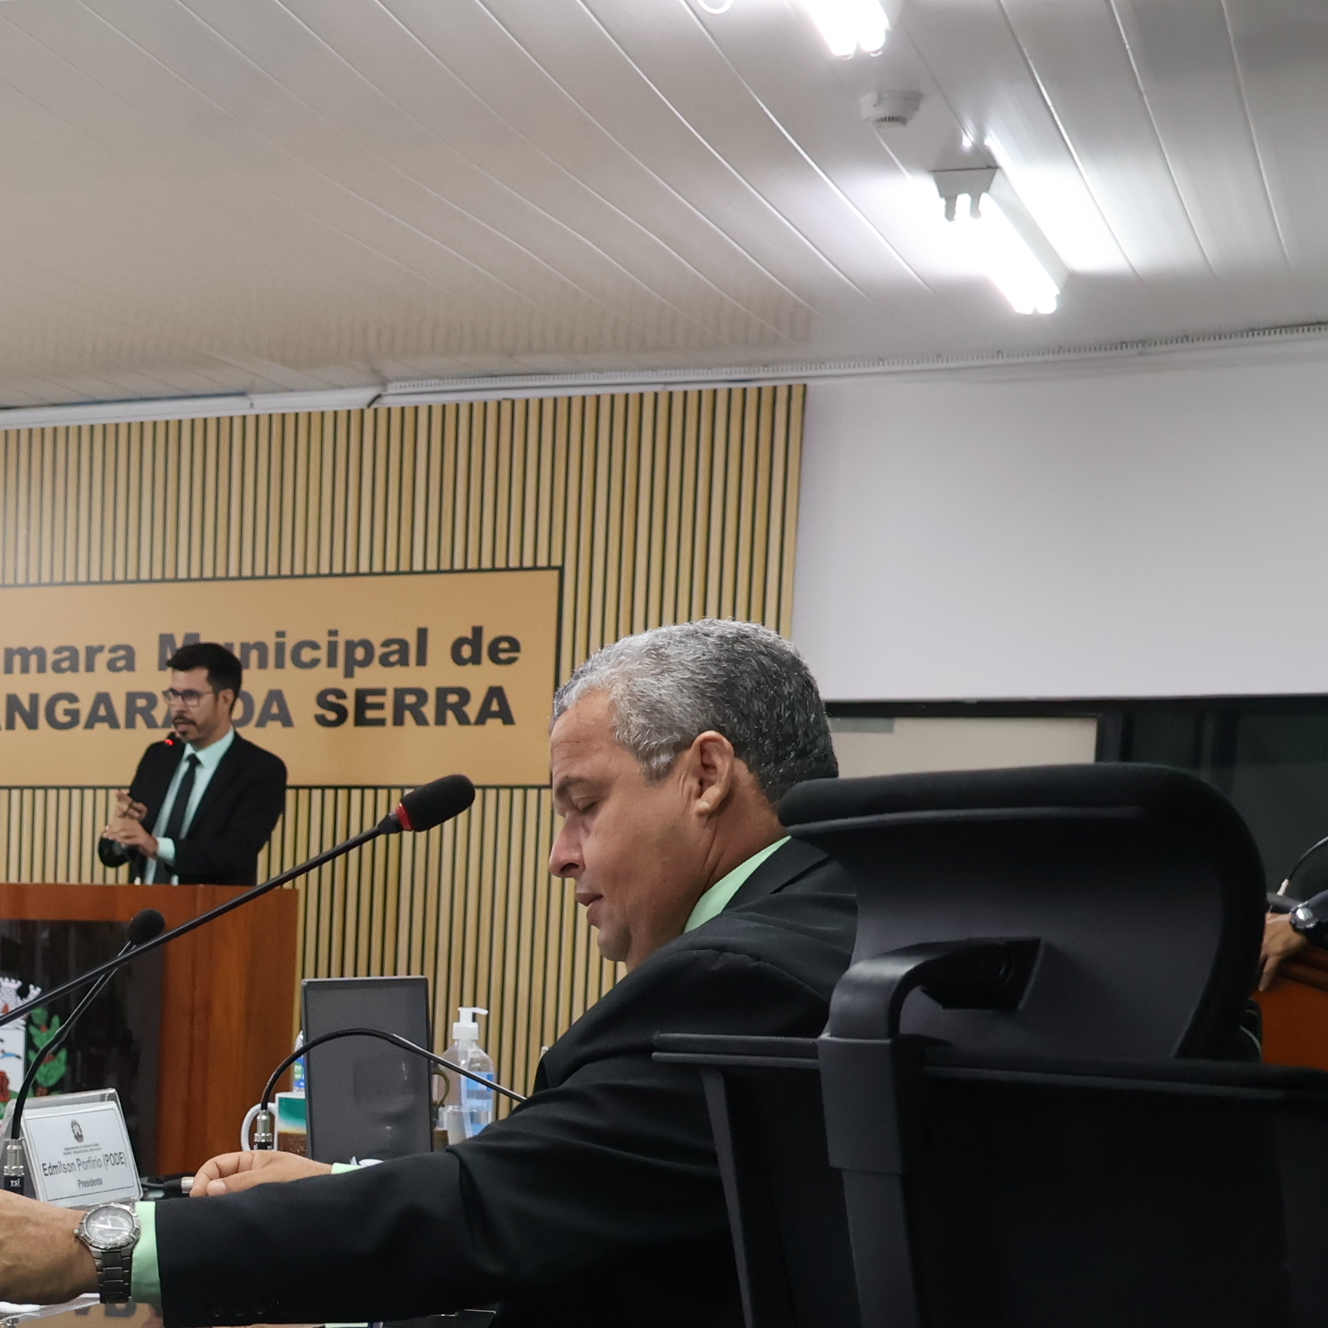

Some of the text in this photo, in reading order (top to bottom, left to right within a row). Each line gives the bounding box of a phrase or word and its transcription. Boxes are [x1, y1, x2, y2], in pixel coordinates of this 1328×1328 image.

[157, 626, 429, 679] Mnicipal
[450, 625, 522, 667] de
[313, 685, 516, 729] SERRA
[41, 1160, 77, 1177] Edmilson
[103, 1151, 128, 1171] (PODE)
